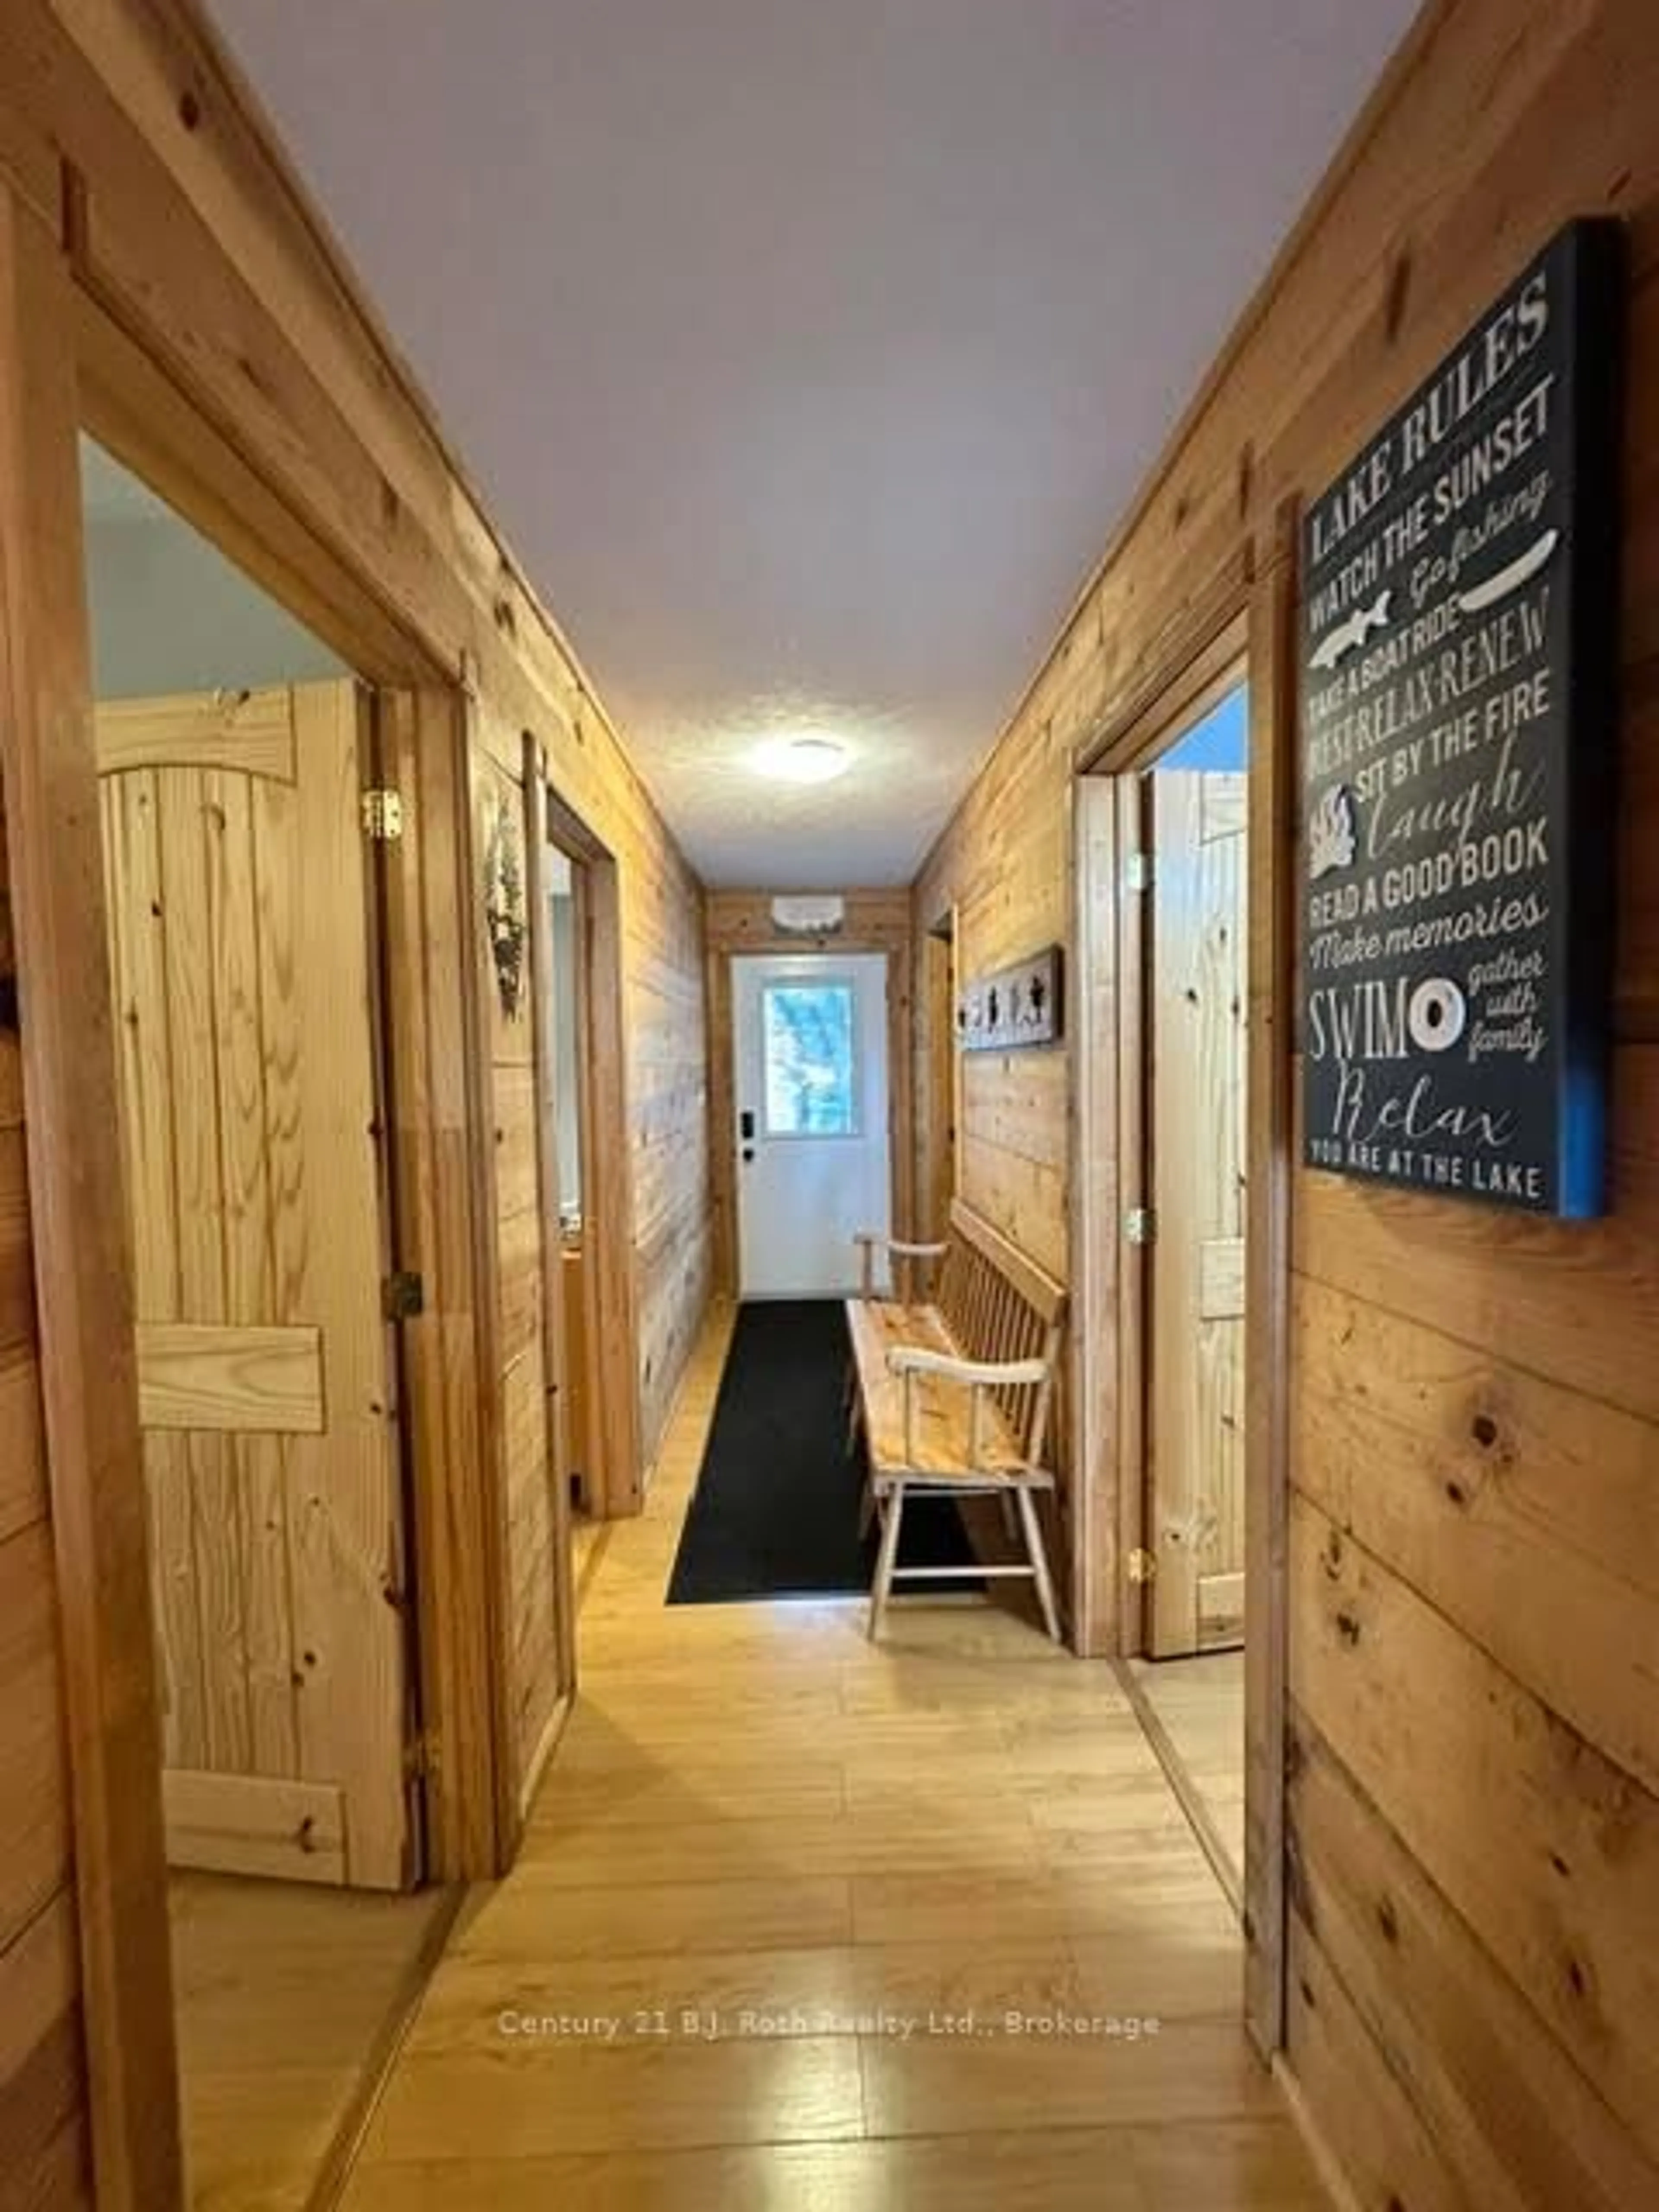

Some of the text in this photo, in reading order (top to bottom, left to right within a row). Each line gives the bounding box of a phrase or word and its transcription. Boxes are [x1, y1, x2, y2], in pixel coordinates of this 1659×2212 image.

[1312, 269, 1548, 563] LAKE RULES
[1310, 372, 1554, 632] WATCH THE SUNSET
[1411, 592, 1460, 655] RIDE
[1355, 667, 1551, 804] SIT BY THE FIRE
[1362, 877, 1378, 921] A
[1382, 851, 1454, 908] GOOD
[1459, 816, 1549, 887] BOOK
[1309, 893, 1550, 969] Make memories
[1308, 976, 1410, 1062] SWIM
[1346, 1142, 1381, 1173] ARE
[1388, 1148, 1412, 1176] AT
[1422, 1153, 1464, 1187] THE
[1471, 1160, 1542, 1198] LAKE
